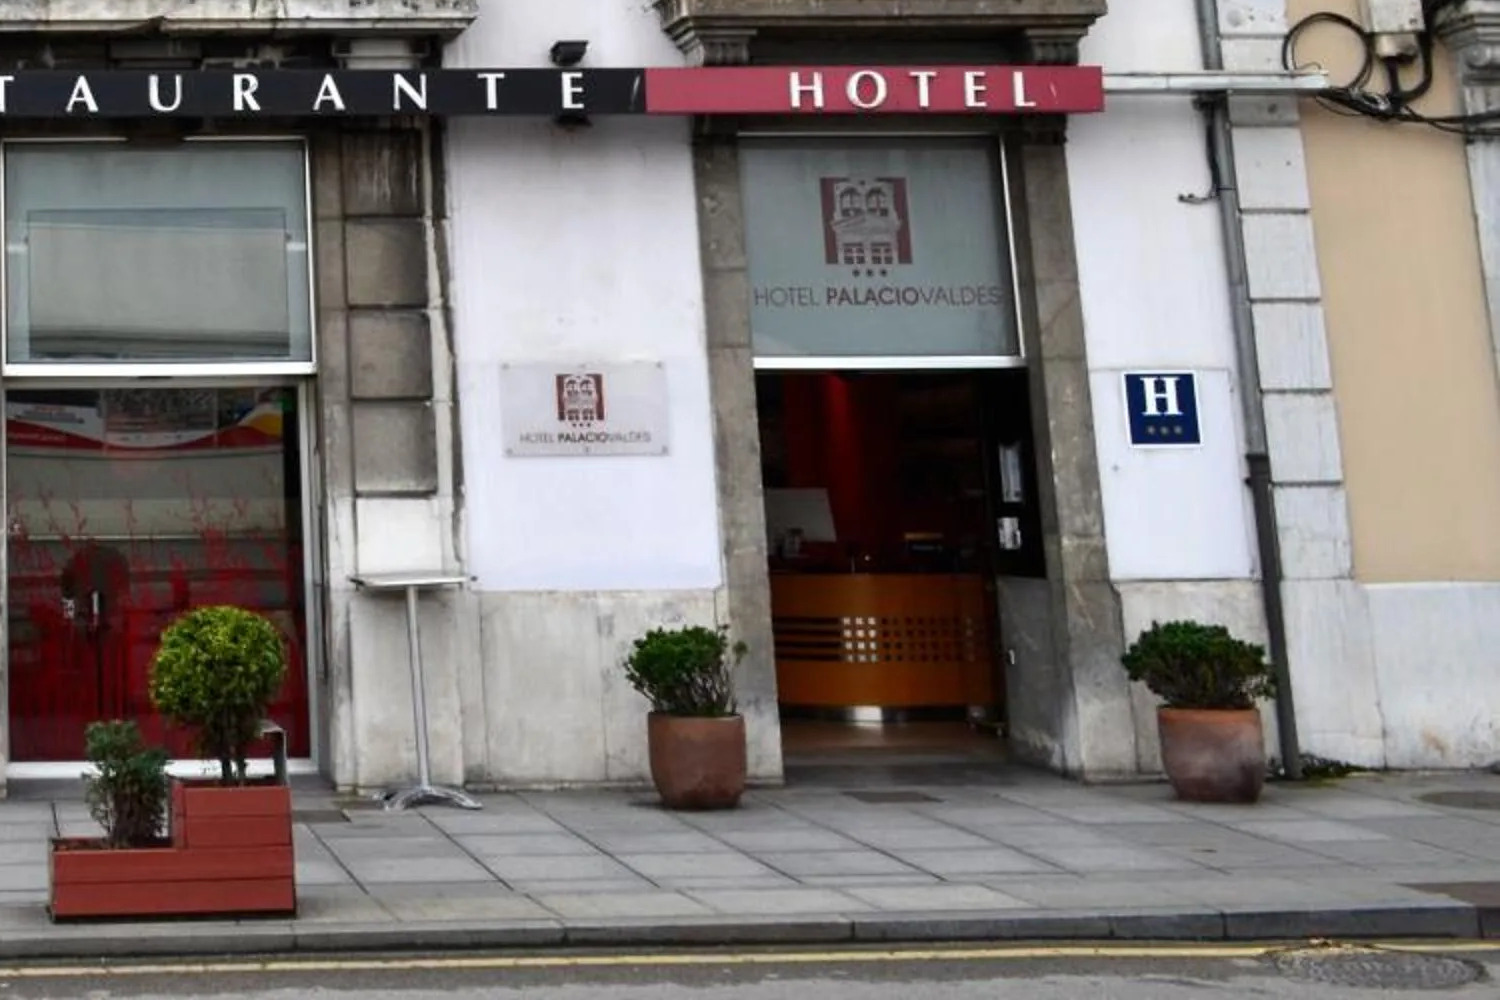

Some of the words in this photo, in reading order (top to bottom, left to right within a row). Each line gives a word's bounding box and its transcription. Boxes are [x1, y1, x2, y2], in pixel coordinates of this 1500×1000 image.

[790, 70, 1036, 108] HOTEL
[754, 286, 820, 307] HOTEL
[1140, 376, 1184, 417] H
[519, 432, 554, 444] HOTEL
